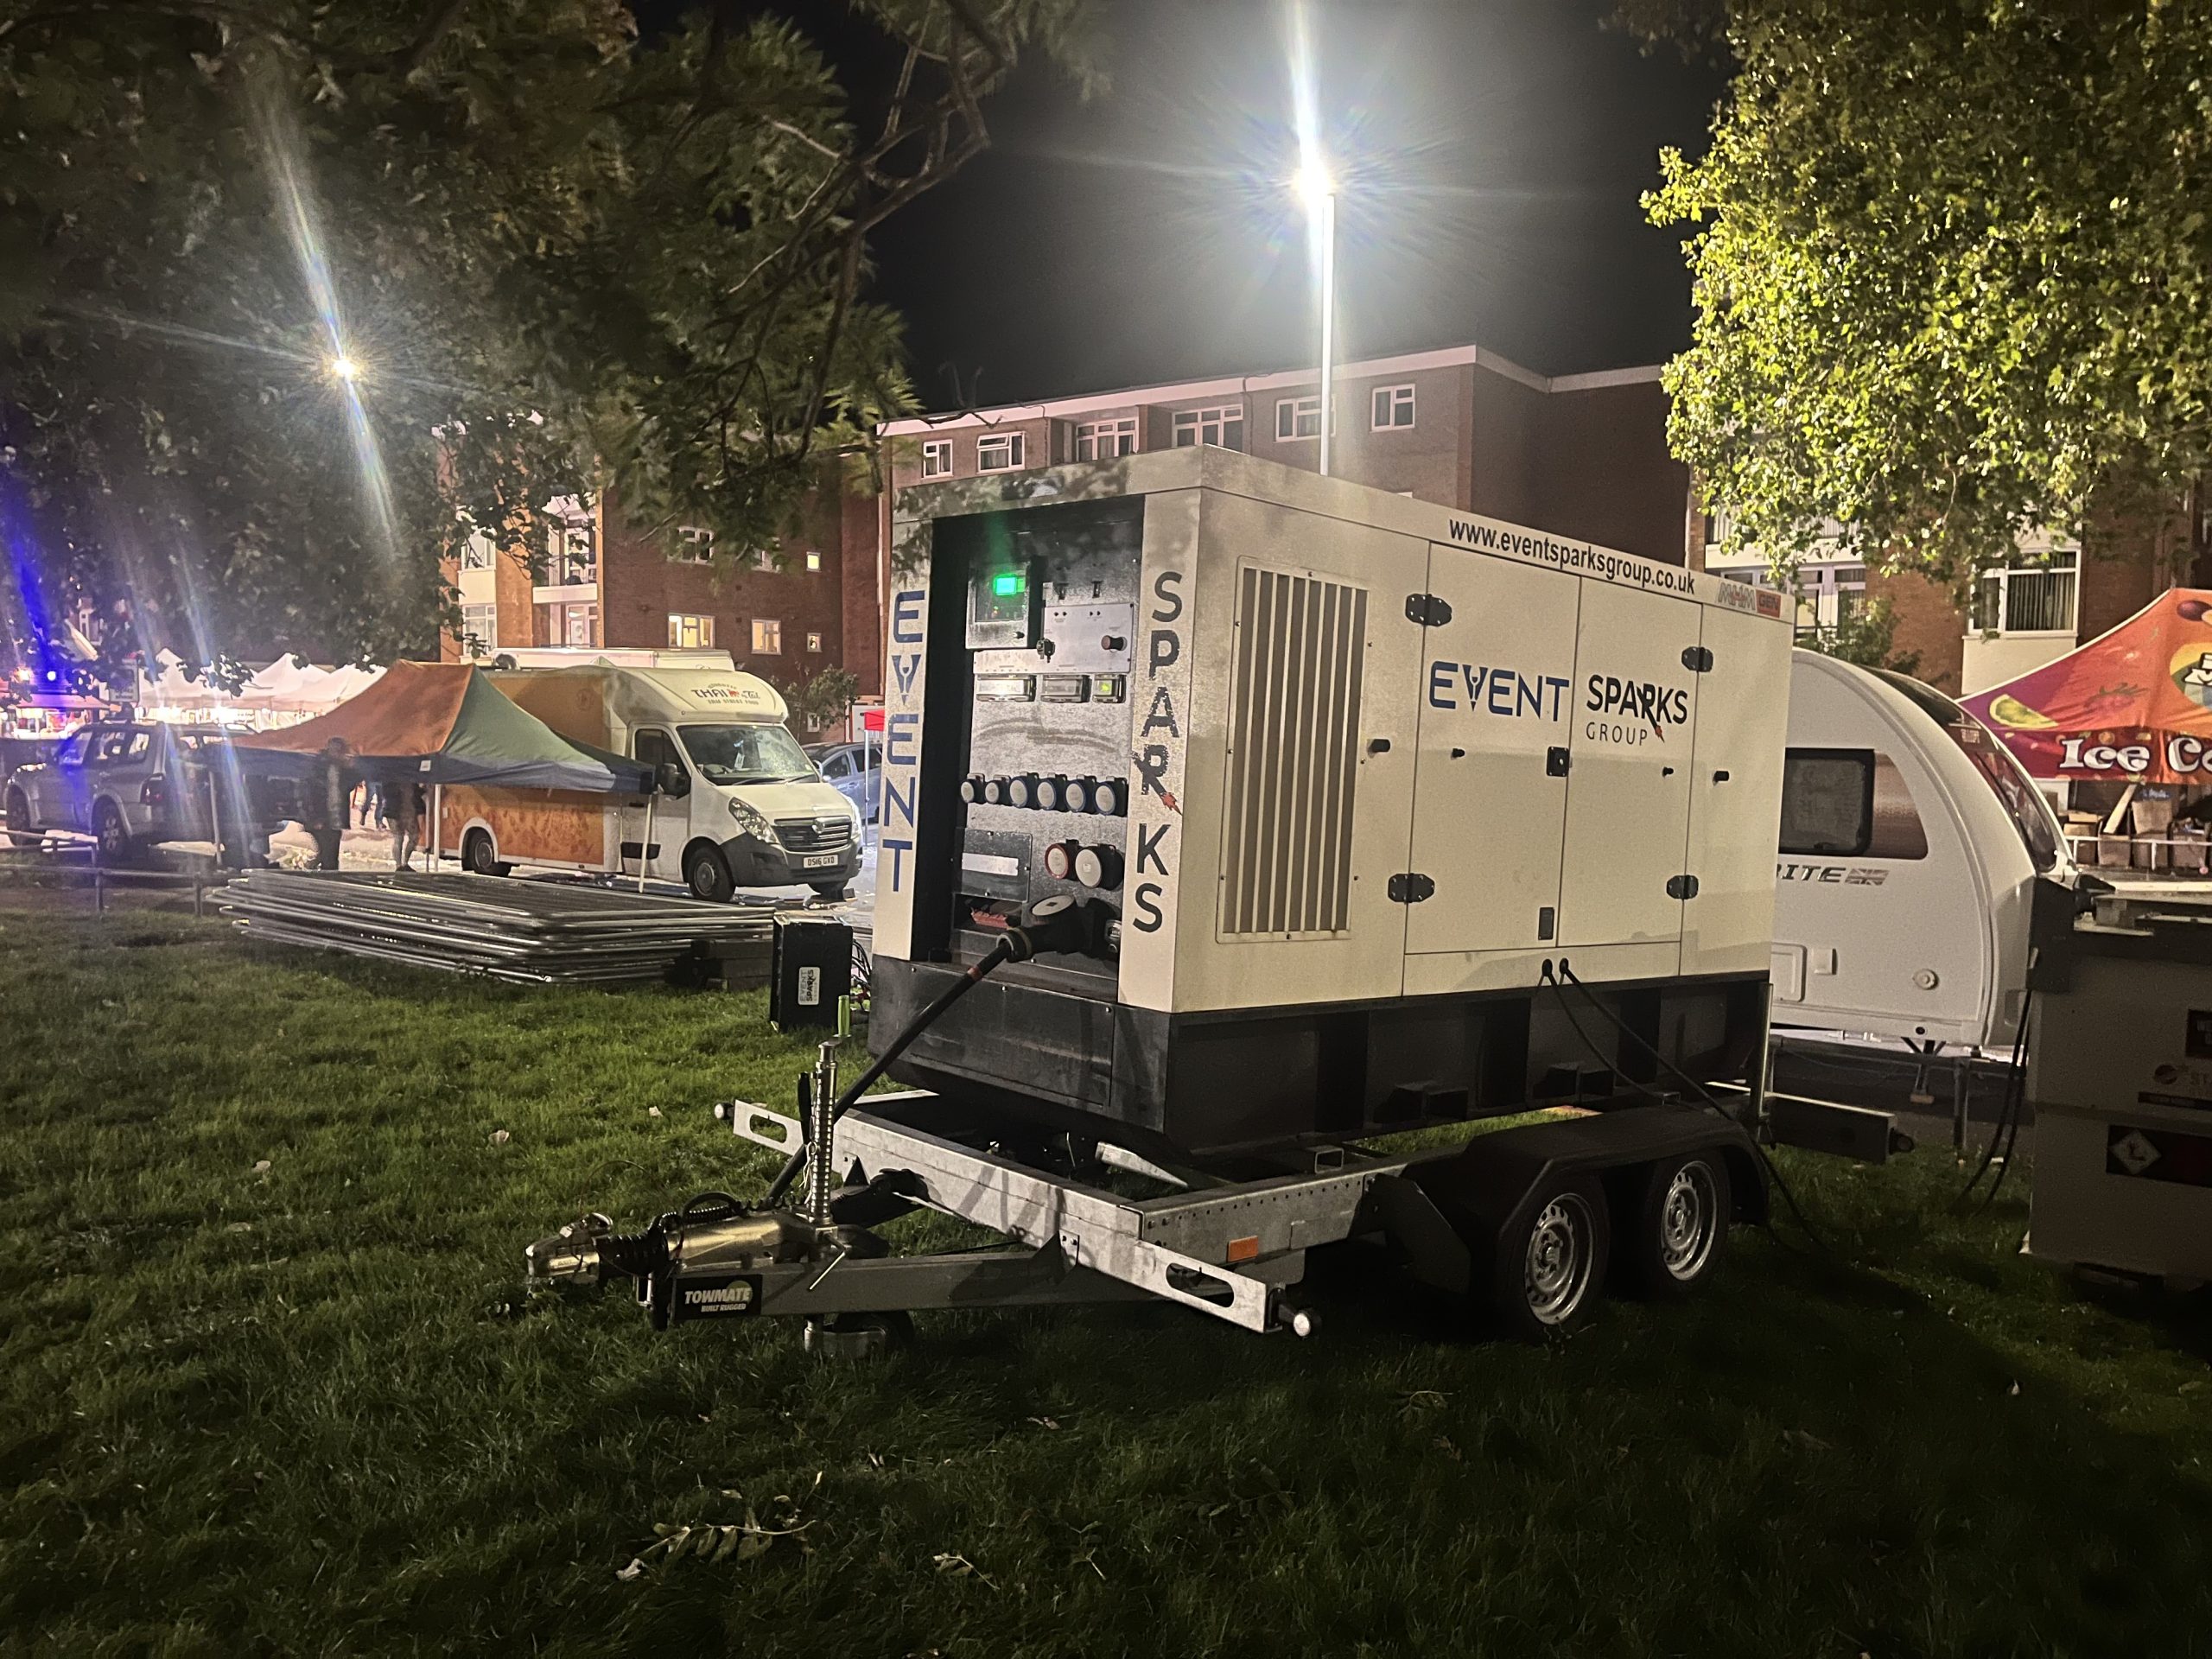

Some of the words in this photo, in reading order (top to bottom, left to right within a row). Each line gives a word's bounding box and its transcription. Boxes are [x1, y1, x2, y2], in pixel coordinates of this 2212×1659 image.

[1449, 518, 1695, 594] www.eventsparksgroup.co.uk
[1429, 660, 1570, 721] EVENT
[1586, 674, 1688, 728] SPARKS
[882, 589, 925, 892] EVENT
[1130, 571, 1182, 933] SPARKS
[1586, 721, 1648, 746] GROUP
[2059, 739, 2150, 772] Ice
[685, 1287, 752, 1305] TOWMATE
[719, 1303, 747, 1312] RUGGED
